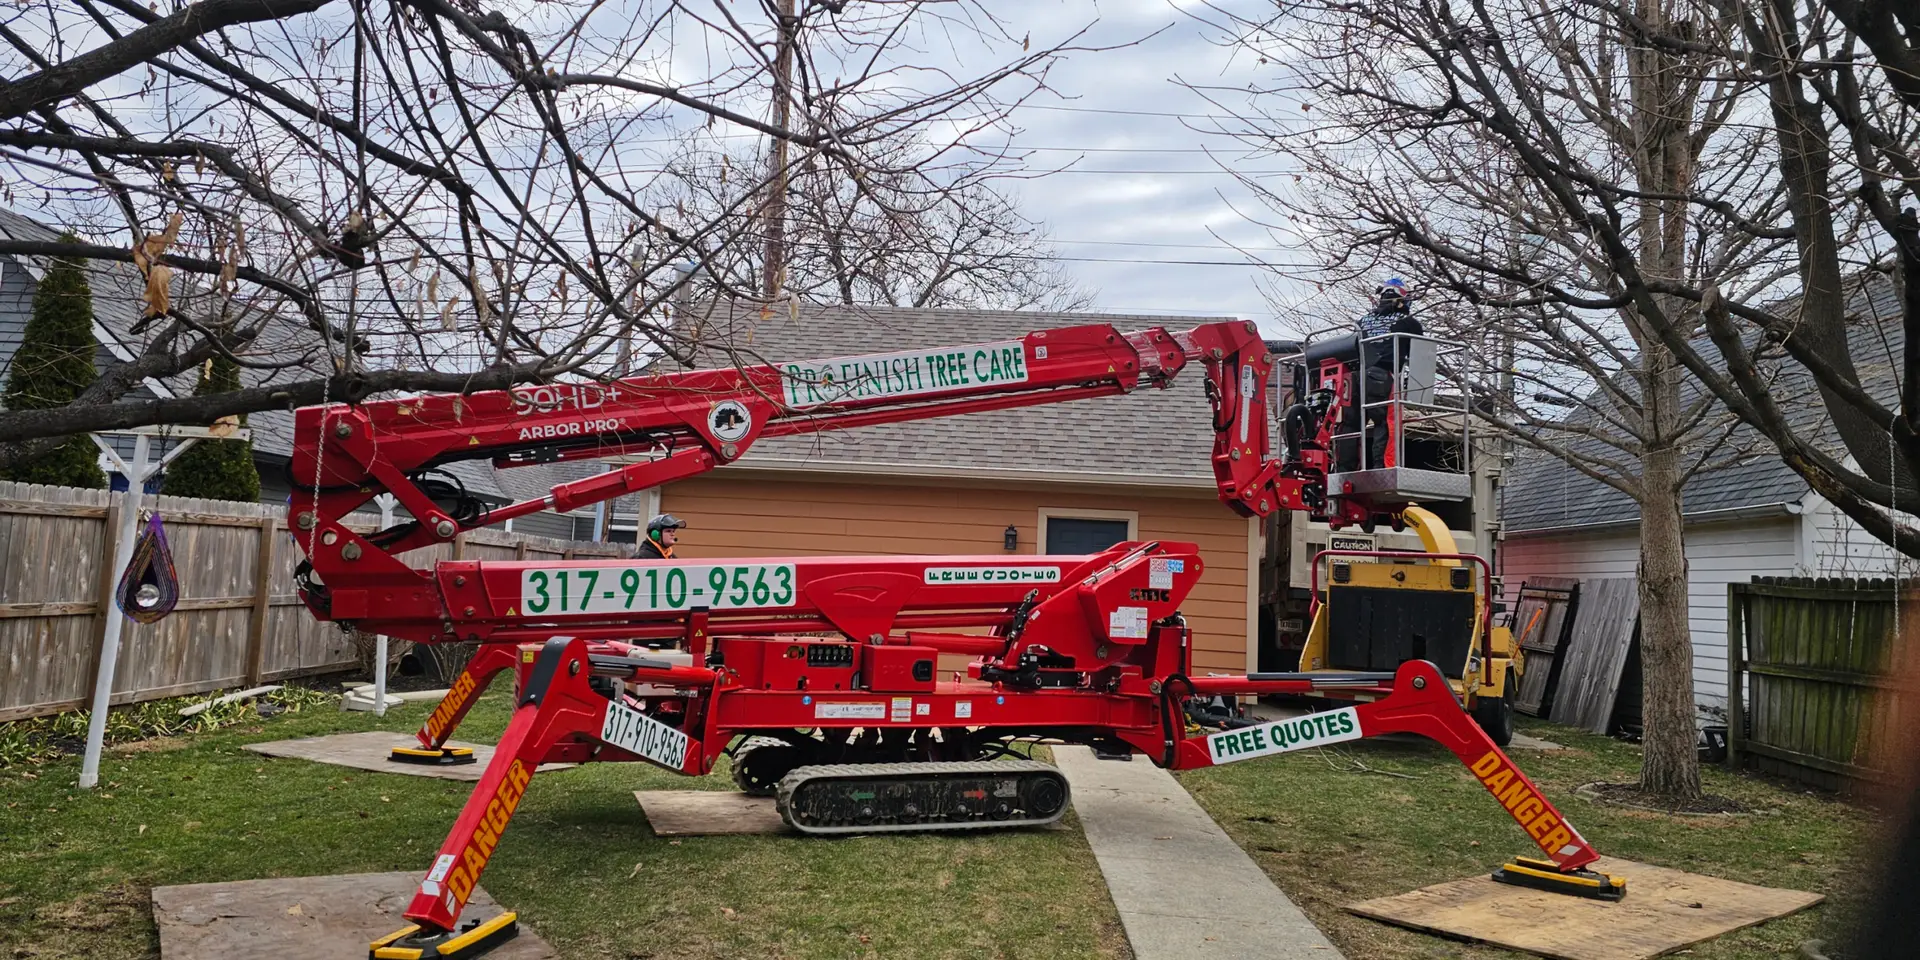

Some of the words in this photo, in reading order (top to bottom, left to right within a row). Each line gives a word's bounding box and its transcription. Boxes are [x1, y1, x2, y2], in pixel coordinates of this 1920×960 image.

[926, 352, 969, 388] TREE
[973, 346, 1026, 383] CARE
[519, 422, 580, 440] ARBOR
[1333, 541, 1371, 551] CAUTION
[527, 565, 793, 614] 317-910-9563
[928, 571, 978, 581] FREE
[982, 570, 1056, 580] QUOTES
[427, 671, 476, 739] DANGER
[604, 704, 686, 769] 317-910-9563
[1213, 728, 1267, 758] FREE
[1270, 712, 1354, 749] QUOTES
[1471, 750, 1571, 855] DANGER
[448, 758, 530, 907] DANGER
